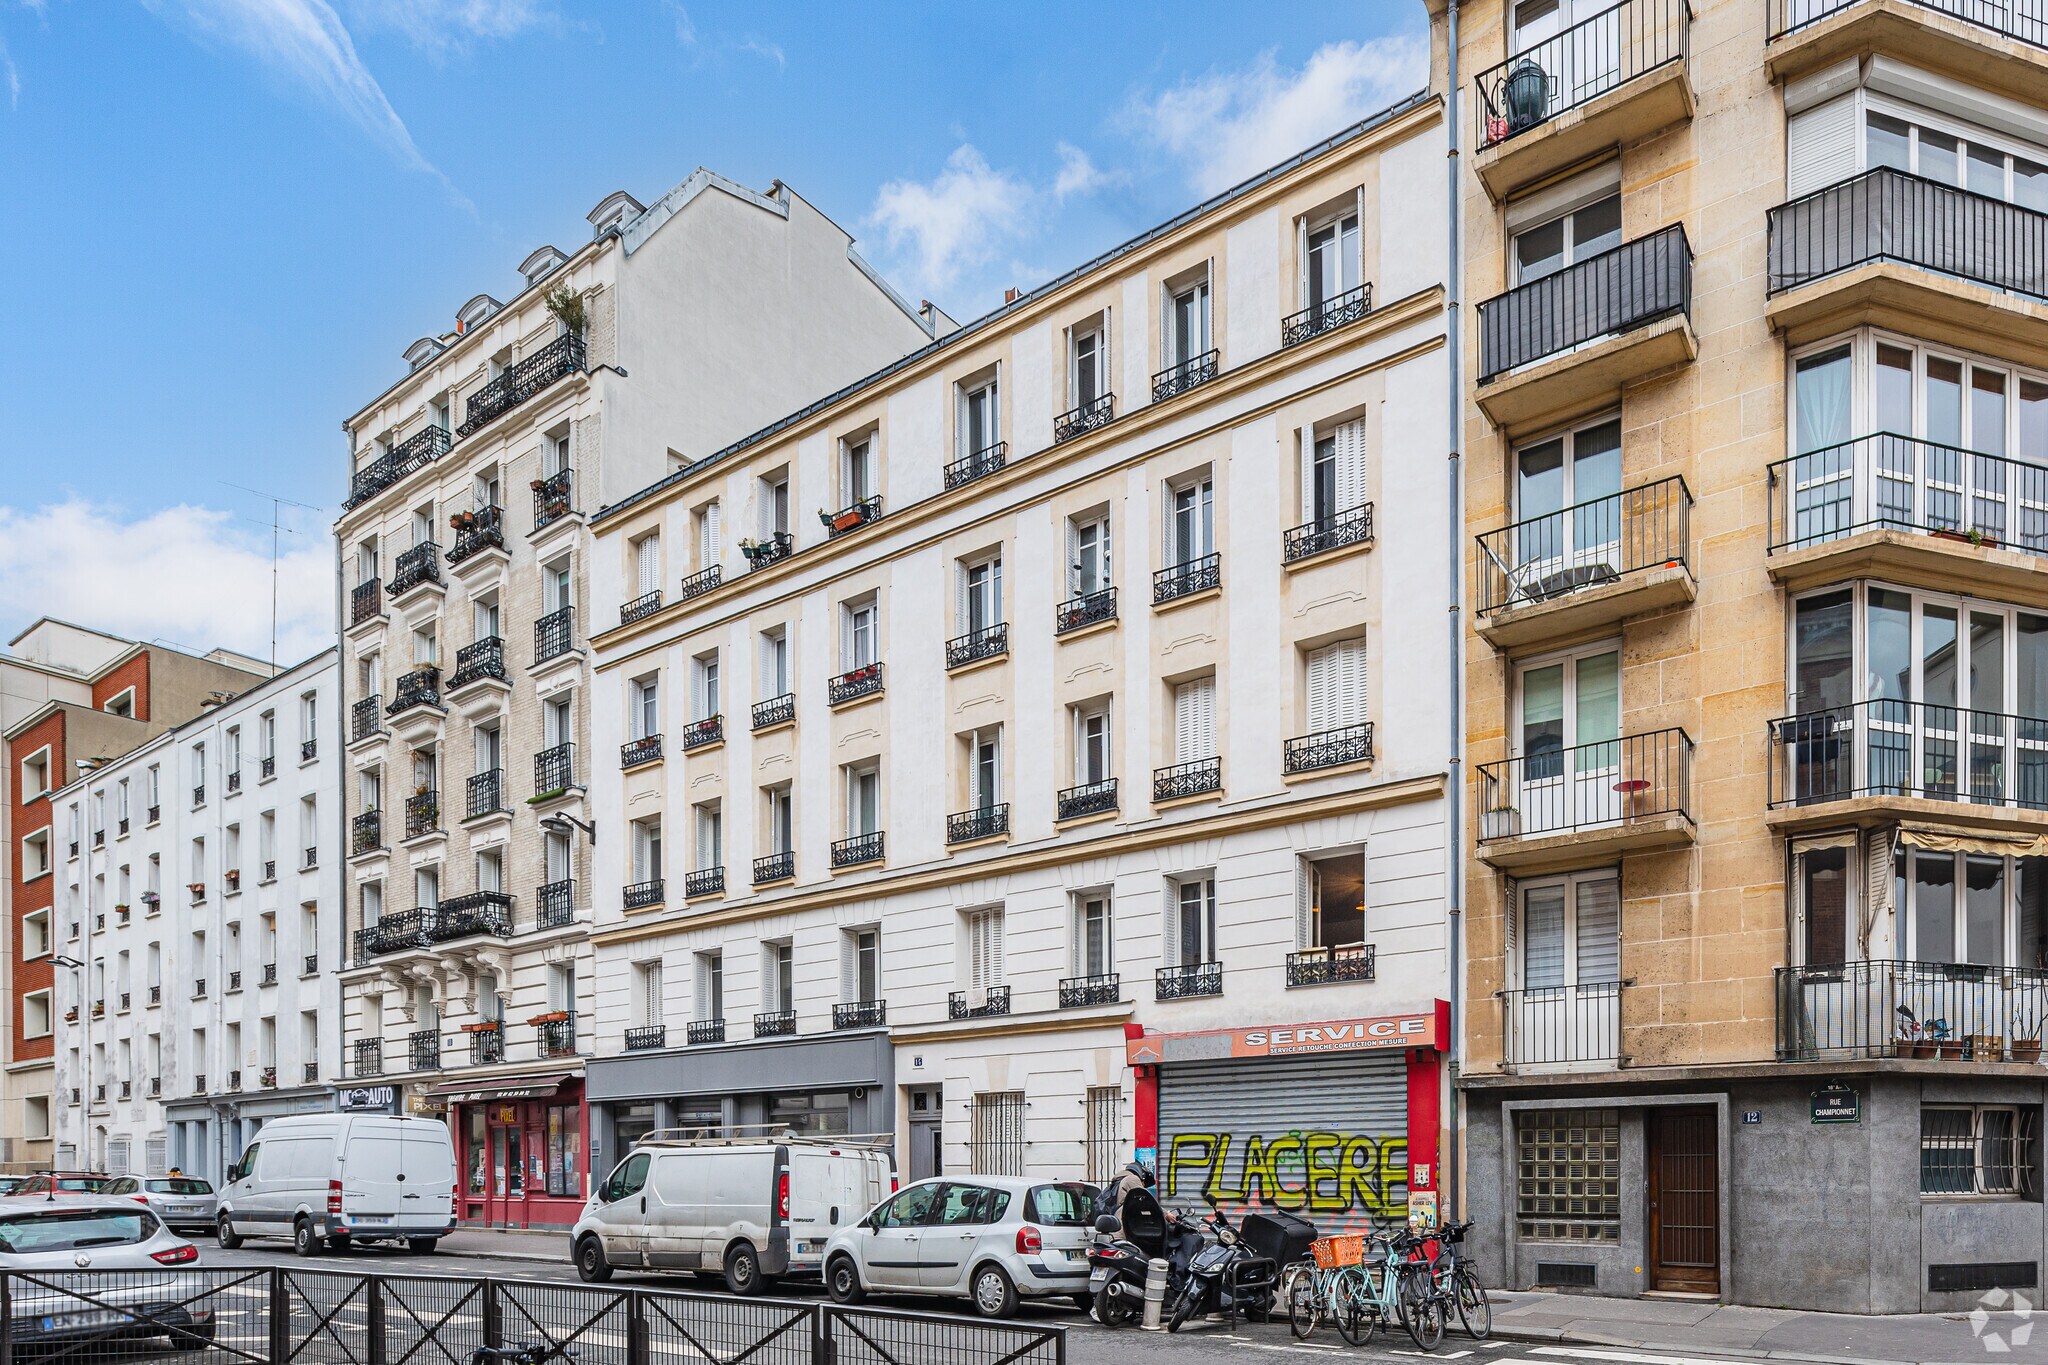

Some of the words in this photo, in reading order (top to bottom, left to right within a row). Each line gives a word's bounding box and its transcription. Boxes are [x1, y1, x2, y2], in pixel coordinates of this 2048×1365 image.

[1245, 1018, 1426, 1046] SERVICE
[1269, 1046, 1297, 1054] SERVICE
[1298, 1043, 1333, 1053] RETOUCHE
[1334, 1040, 1377, 1050] CONFECTION
[1378, 1037, 1408, 1046] MESURE
[339, 1089, 353, 1107] MC
[367, 1086, 393, 1105] AUTO
[413, 1103, 445, 1111] PIXEL
[1829, 1098, 1842, 1106] RUE
[1815, 1107, 1856, 1116] CHAMPIONNET
[1747, 1112, 1758, 1122] 12
